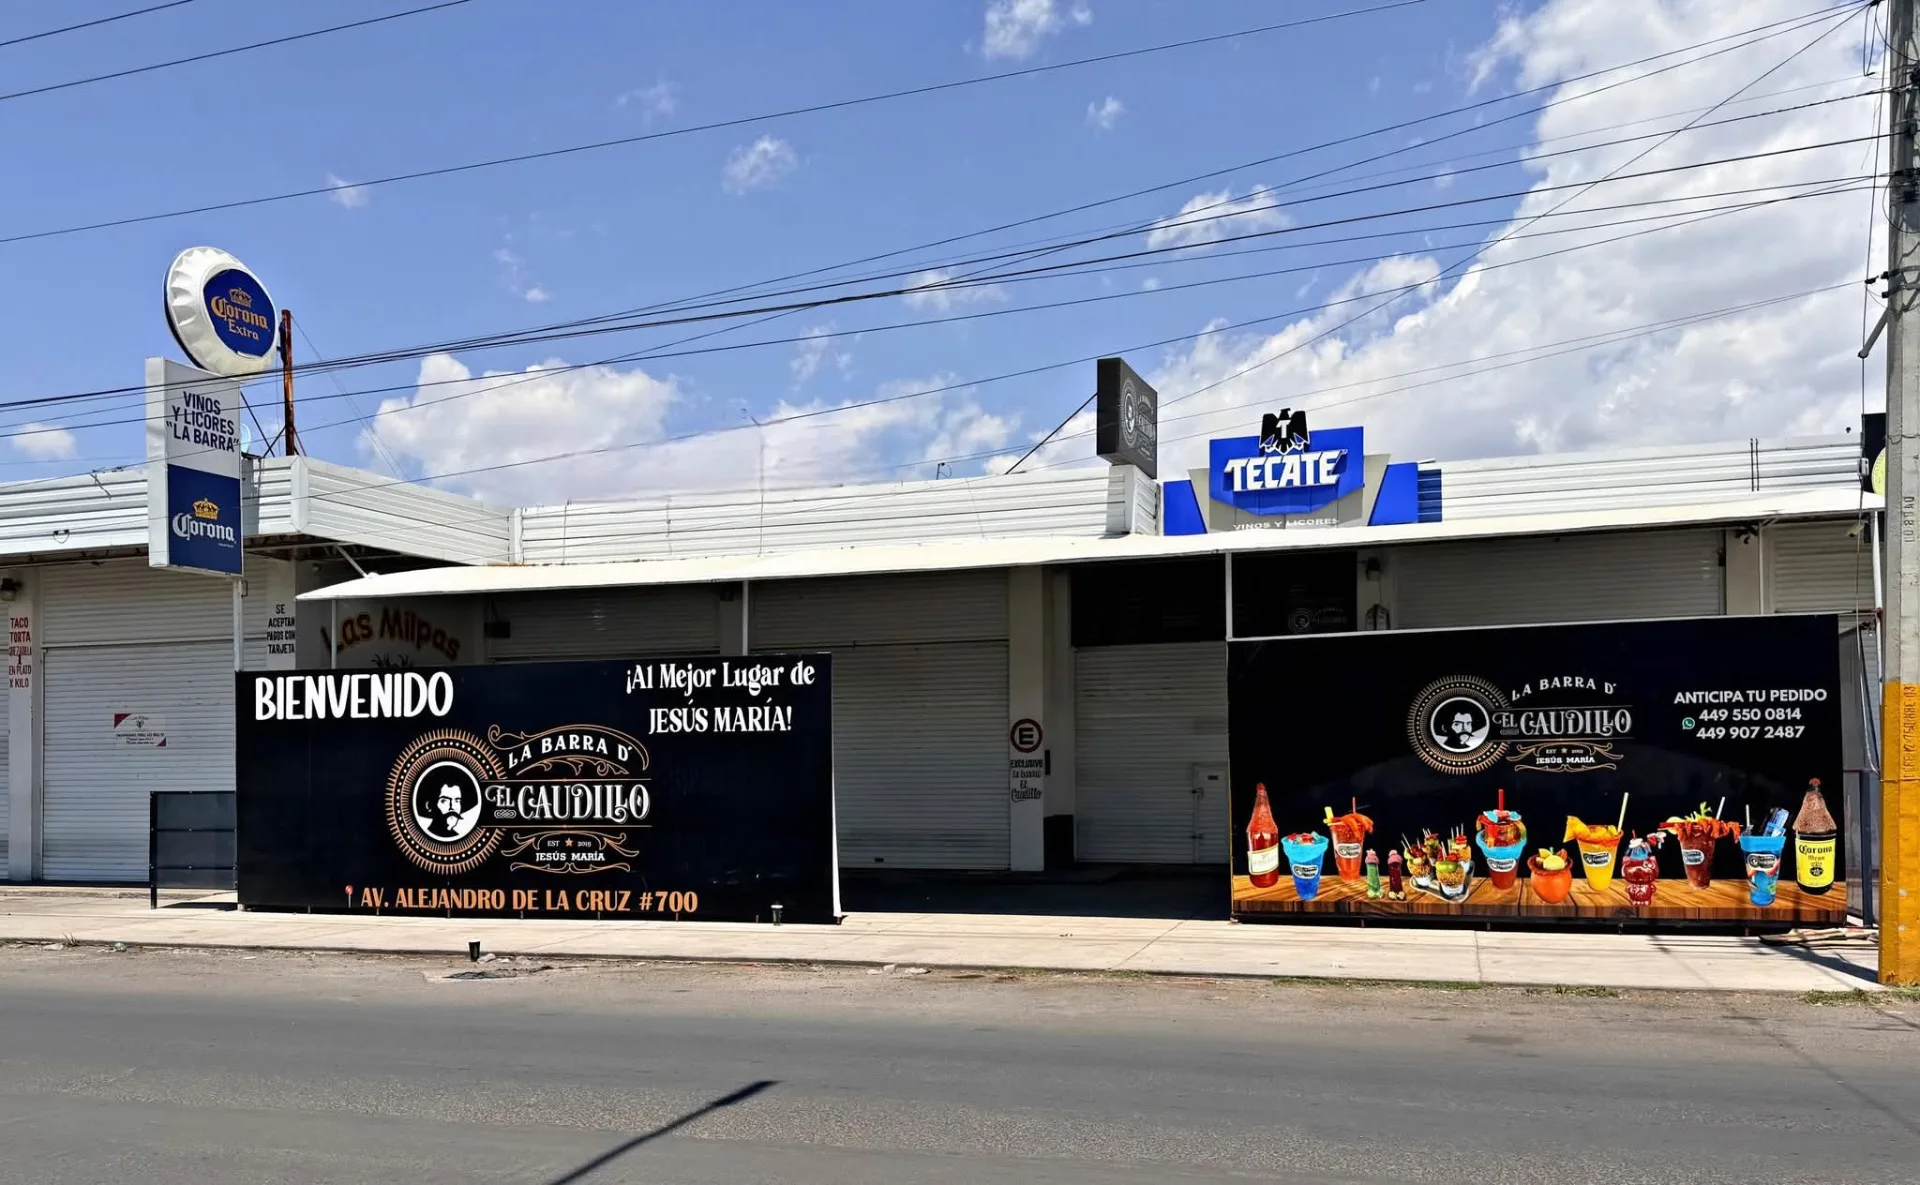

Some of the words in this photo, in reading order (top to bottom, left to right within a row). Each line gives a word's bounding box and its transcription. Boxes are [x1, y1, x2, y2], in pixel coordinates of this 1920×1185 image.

[211, 296, 268, 329] Corona
[228, 320, 259, 340] Extra
[183, 391, 221, 415] VINOS
[171, 405, 181, 422] Y
[184, 410, 235, 435] LICORES
[1223, 449, 1348, 493] TECATE
[172, 513, 235, 541] Corona
[1233, 522, 1271, 530] VINOS
[1285, 518, 1340, 527] LICORES
[275, 604, 286, 614] SE
[10, 616, 29, 629] TACO
[268, 617, 295, 628] ACEPTAN
[9, 631, 31, 643] TORTA
[266, 630, 283, 641] PAGOS
[284, 630, 295, 640] CON
[320, 613, 373, 655] Las
[380, 607, 461, 662] Milpas
[267, 643, 295, 654] TARJETA
[8, 665, 16, 675] EN
[16, 665, 32, 675] PLATO
[626, 664, 653, 694] ¡Al
[659, 663, 716, 697] Mejor
[722, 662, 785, 696] Lugar
[790, 660, 815, 685] de
[9, 678, 14, 688] X
[14, 677, 29, 688] KILO
[1511, 684, 1532, 701] LA
[1539, 676, 1596, 690] BARRA
[255, 671, 454, 721] BIENVENIDO
[1674, 690, 1744, 704] ANTICIPA
[1746, 689, 1766, 703] TU
[1770, 688, 1828, 702] PEDIDO
[648, 698, 708, 735] JESÚS
[713, 697, 793, 732] MARÍA!
[1519, 708, 1632, 737] CAUDILLO
[1699, 709, 1729, 721] 449
[1732, 708, 1761, 721] 550
[1765, 707, 1802, 720] 0814
[1018, 727, 1034, 745] E
[1696, 726, 1726, 739] 449
[1729, 726, 1760, 739] 907
[1764, 725, 1806, 739] 2487
[508, 744, 532, 769] LA
[541, 734, 608, 755] BARRA
[1566, 756, 1595, 764] MARÍA
[517, 783, 650, 824] CAUDILLO
[535, 851, 566, 862] JESÚS
[571, 851, 605, 862] MARÍA
[1799, 844, 1832, 855] Corona
[361, 887, 389, 908] AV.
[395, 887, 505, 910] ALEJANDRO
[512, 889, 539, 910] DE
[545, 889, 570, 911] LA
[575, 889, 631, 912] CRUZ
[638, 890, 699, 913] #700
